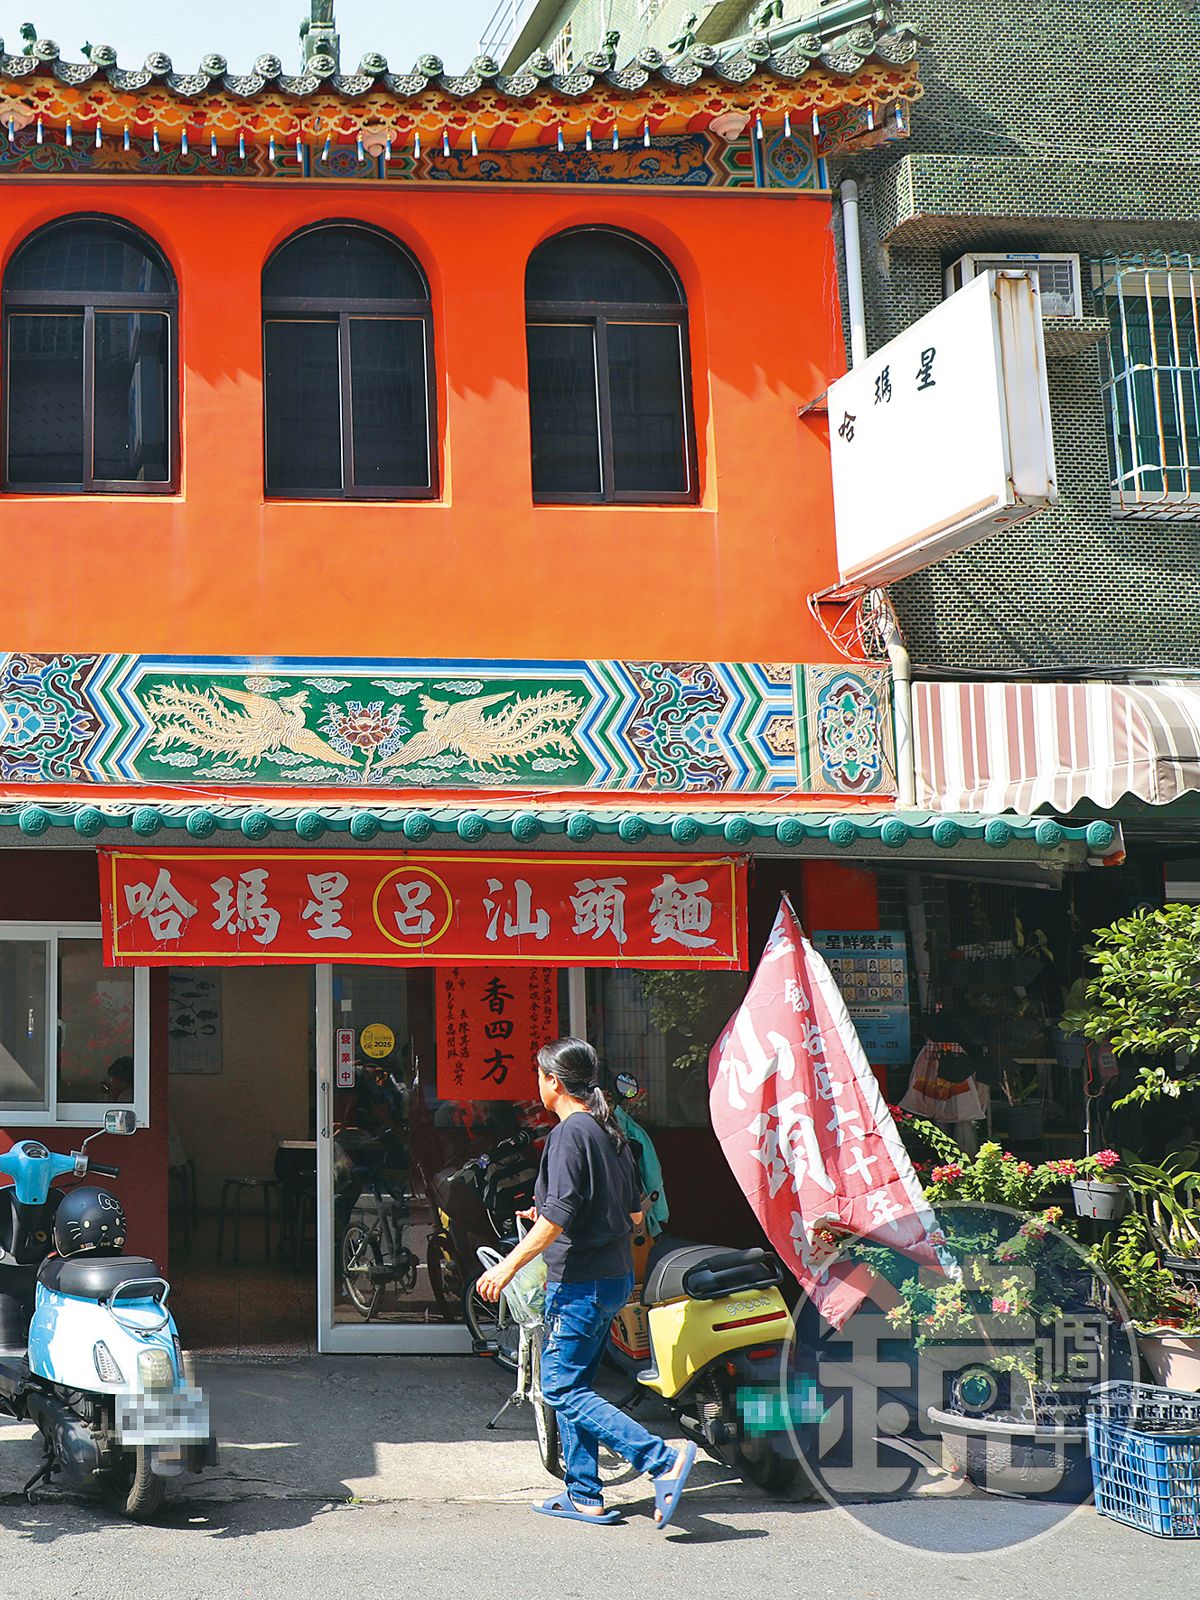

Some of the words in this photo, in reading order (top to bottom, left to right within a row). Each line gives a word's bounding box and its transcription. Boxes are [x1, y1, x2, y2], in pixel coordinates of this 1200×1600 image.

[838, 347, 937, 443] 哈瑪星
[825, 935, 894, 950] 星鮮餐桌
[480, 977, 515, 1085] 香四方
[341, 1034, 351, 1082] 營業中
[724, 1294, 771, 1317] gogoro
